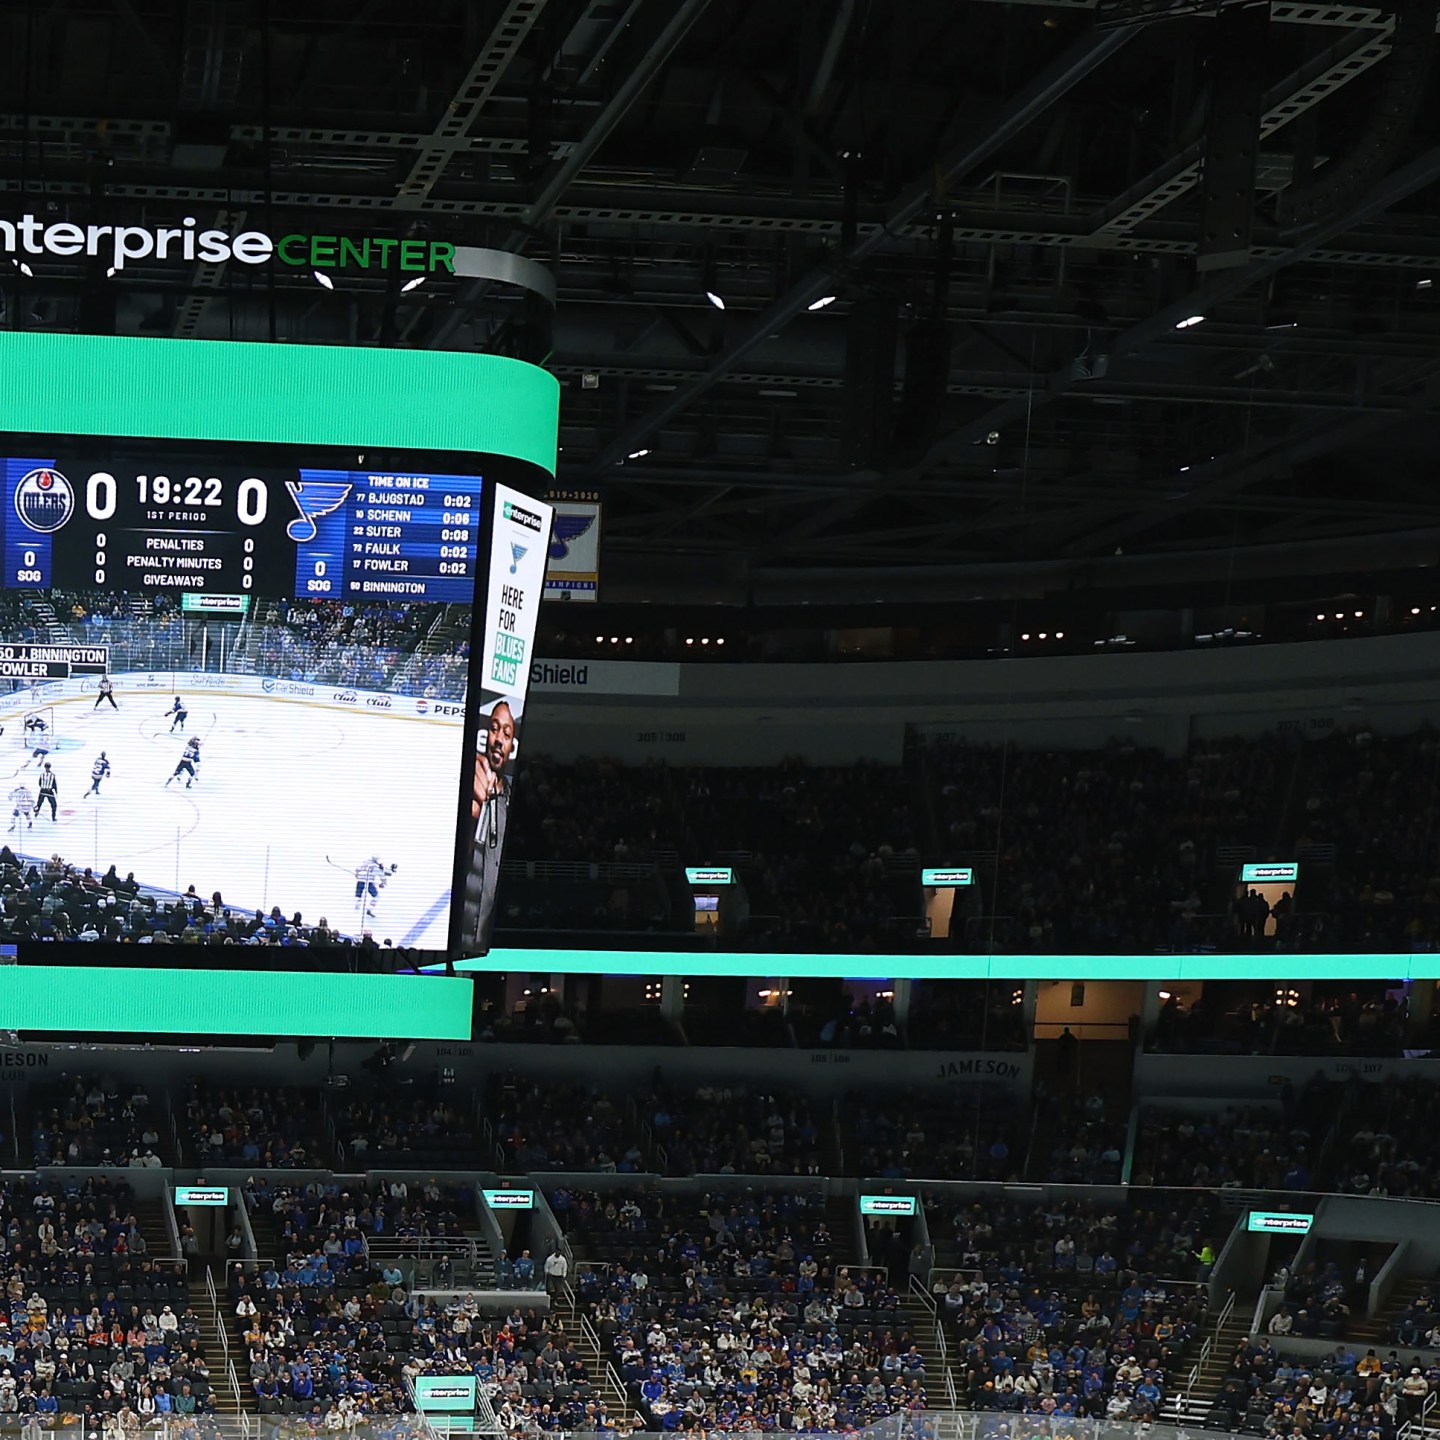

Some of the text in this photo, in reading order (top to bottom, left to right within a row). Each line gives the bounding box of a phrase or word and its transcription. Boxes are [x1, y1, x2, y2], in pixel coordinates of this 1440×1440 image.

[278, 231, 456, 274] CENTER
[136, 475, 223, 506] 19:22
[368, 476, 430, 489] TIME ON ICE
[86, 472, 117, 520] 0
[237, 478, 268, 526] 0
[368, 493, 471, 508] BJUGSTAD 0:02
[146, 511, 207, 521] 1ST PERIOD
[367, 510, 411, 522] SCHENN
[503, 503, 542, 530] enterprise
[366, 526, 469, 541] SUTER 0:08
[96, 533, 254, 553] 0 PENALTIES 0
[365, 543, 467, 559] FAULK 0:02
[24, 551, 36, 567] 0
[96, 551, 253, 571] 0 PENALTY MINUTES 0
[364, 560, 467, 574] FOWLER 0:02
[17, 570, 41, 582] SOG
[314, 561, 326, 577] 0
[95, 569, 252, 589] 0 GIVEAWAYS 0
[307, 580, 331, 592] SOG
[363, 581, 426, 594] BINNINGTON
[501, 584, 525, 610] HERE
[498, 608, 515, 632] FOR
[495, 632, 525, 661] BLUES
[491, 660, 516, 685] FANS
[936, 1058, 1021, 1081] JAMESON
[422, 1388, 471, 1398] enterprise
